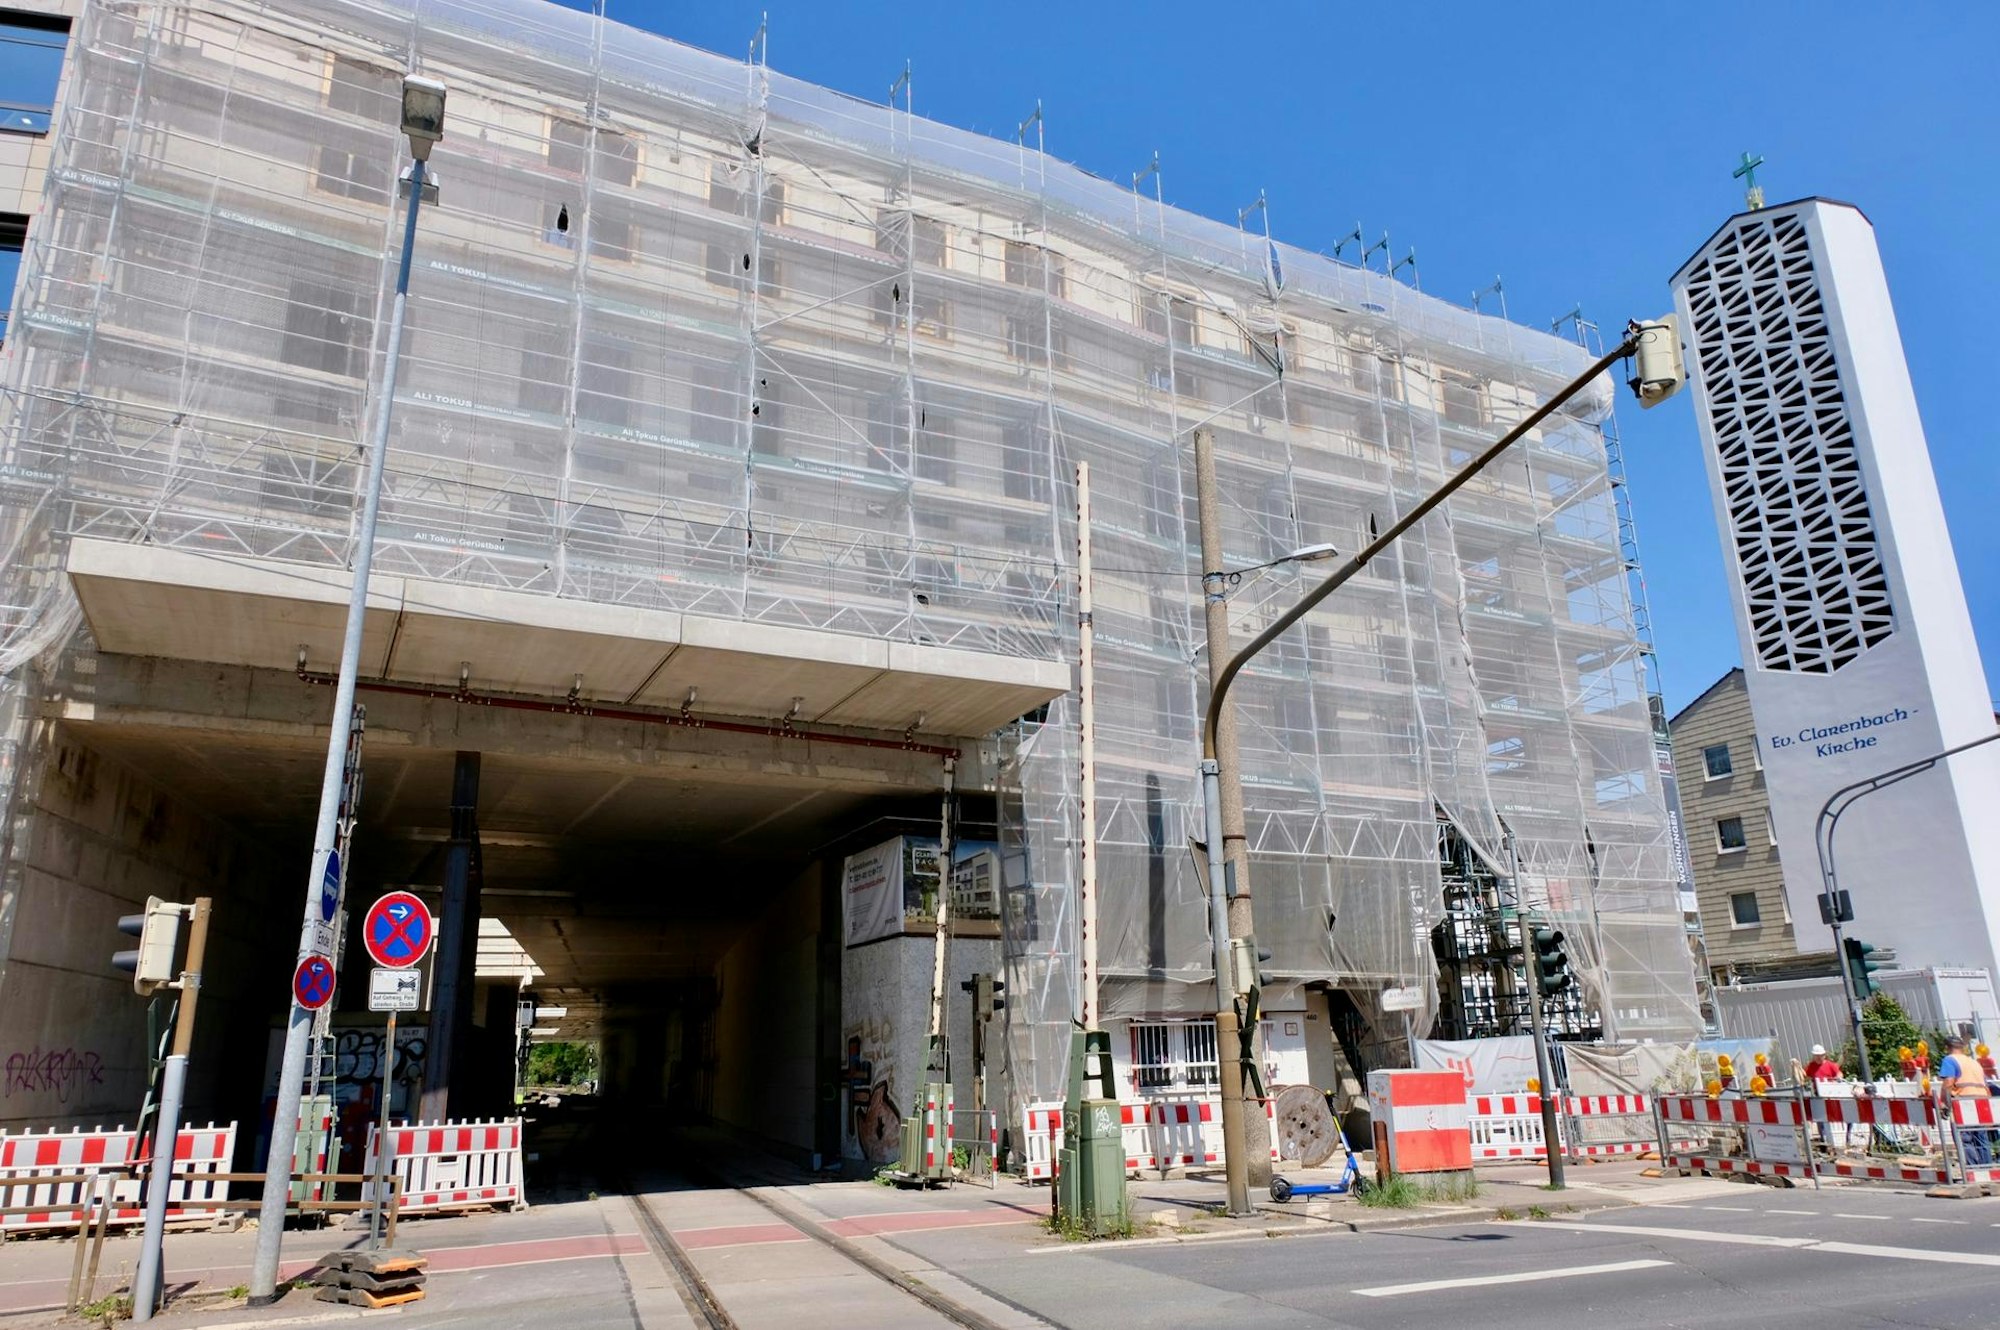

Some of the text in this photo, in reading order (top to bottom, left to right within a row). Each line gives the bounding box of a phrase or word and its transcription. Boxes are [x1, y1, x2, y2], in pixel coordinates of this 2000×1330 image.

[80, 174, 112, 187] Tokus
[430, 261, 448, 270] ALI
[451, 265, 487, 279] TOKUS
[414, 391, 431, 400] ALI
[435, 395, 472, 408] TOKUS
[414, 532, 505, 551] Ali Tokus Gerüstbau
[1771, 735, 1796, 749] Ev.
[1798, 708, 1908, 743] Clarenbach
[1816, 736, 1877, 757] Kirche
[1669, 811, 1687, 884] WOHNUNGEN
[318, 930, 330, 948] Ende
